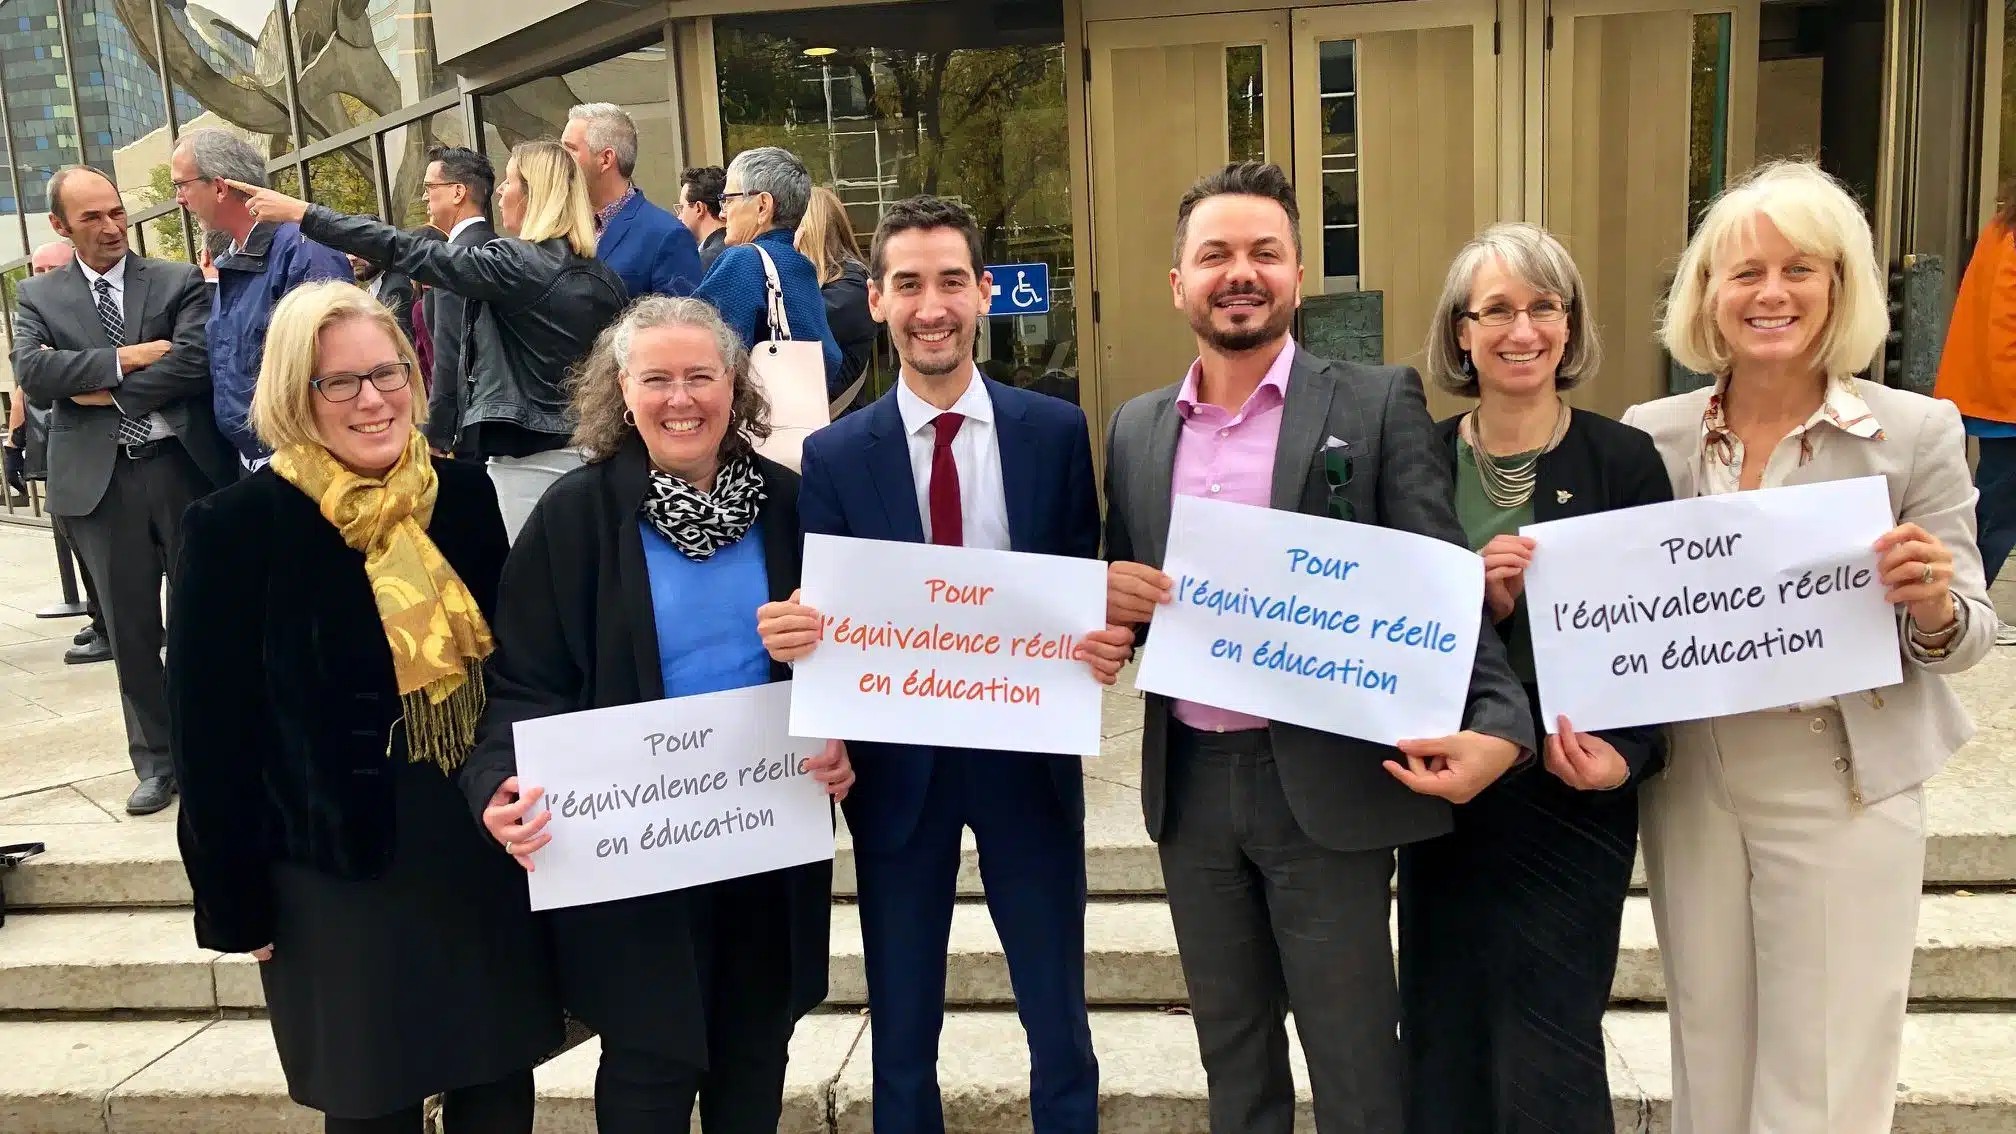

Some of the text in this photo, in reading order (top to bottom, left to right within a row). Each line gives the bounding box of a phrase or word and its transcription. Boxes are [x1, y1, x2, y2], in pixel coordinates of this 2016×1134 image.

[1286, 548, 1360, 581] Pour
[1660, 532, 1743, 565] Pour
[925, 579, 995, 607] Pour
[1554, 564, 1873, 634] l'équivalence réelle
[819, 614, 1000, 655] l'équivalence
[1179, 575, 1457, 653] l'équivalence réelle
[1210, 637, 1398, 695] en éducation
[1611, 627, 1825, 677] en éducation
[859, 669, 1041, 706] en éducation
[643, 727, 714, 757] Pour
[596, 807, 775, 858] en éducation
